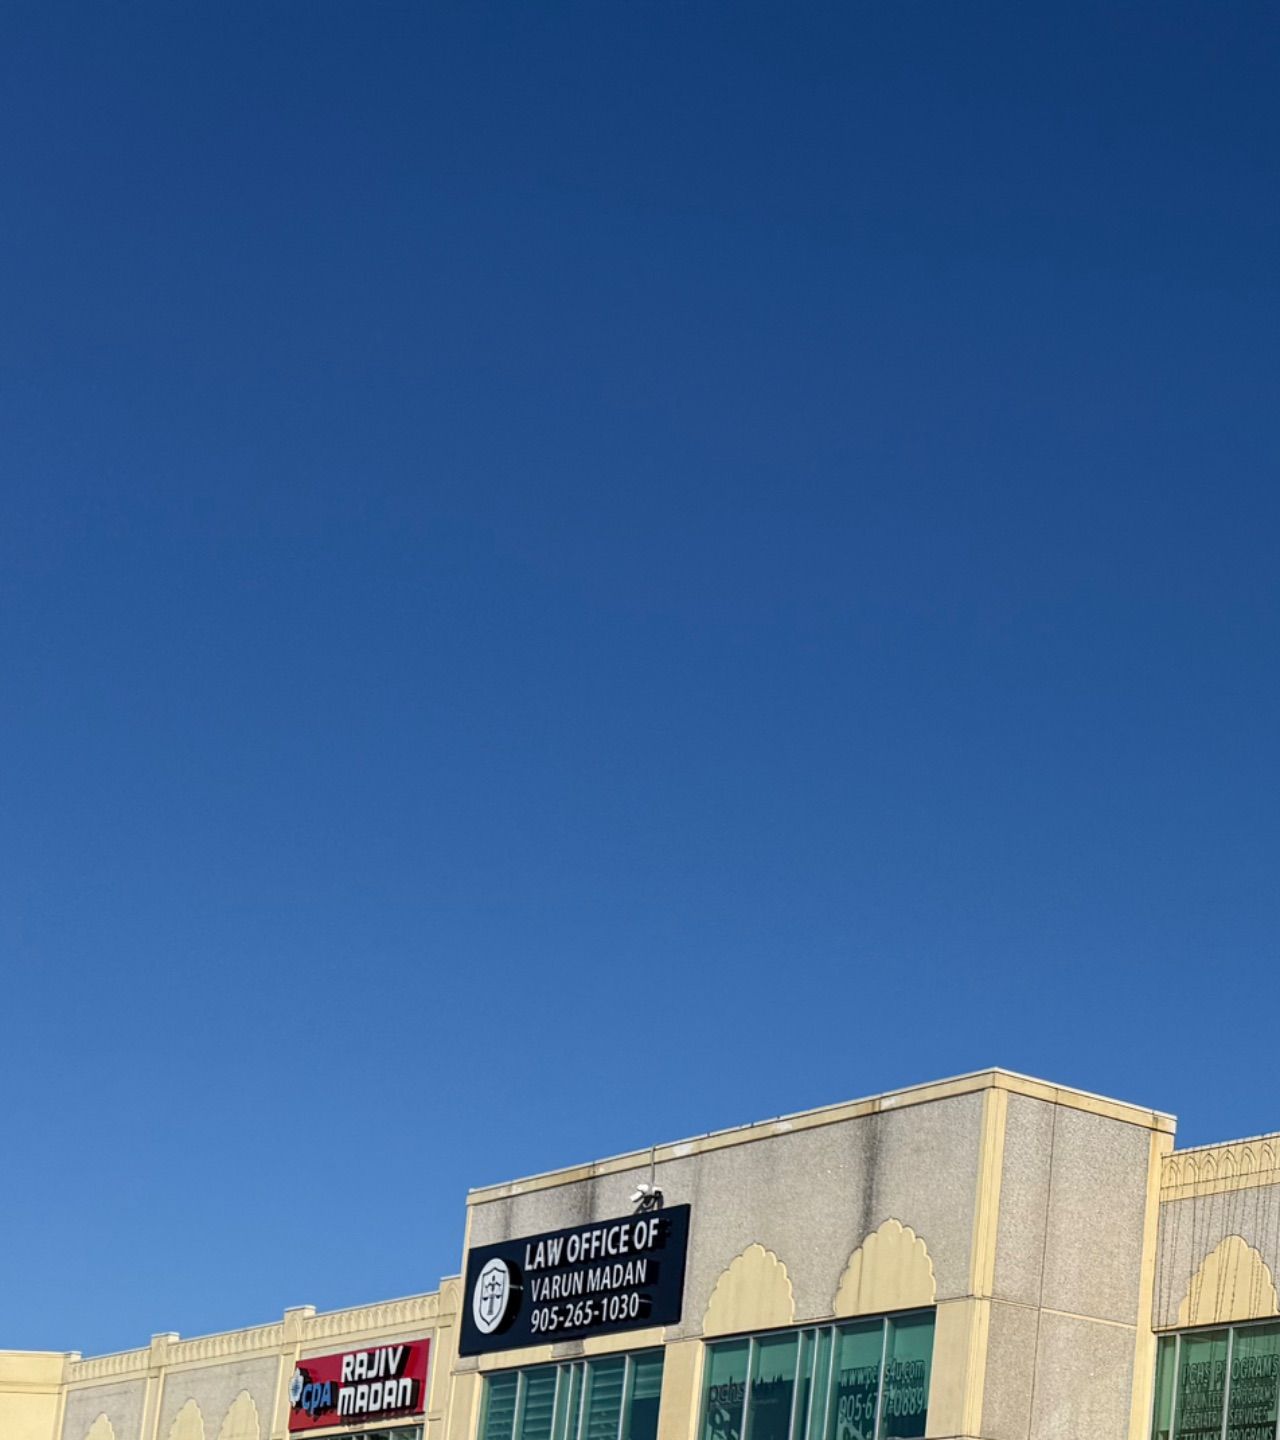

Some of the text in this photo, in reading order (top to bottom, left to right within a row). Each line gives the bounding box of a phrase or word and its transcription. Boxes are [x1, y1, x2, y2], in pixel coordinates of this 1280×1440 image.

[525, 1218, 660, 1271] LAW OFFICE OF
[531, 1258, 647, 1302] VARUN MADAN
[531, 1292, 640, 1333] 905-265-1030
[341, 1345, 404, 1382] RAJIV
[1216, 1354, 1280, 1381] POGRAMS
[337, 1378, 412, 1416] MADAN
